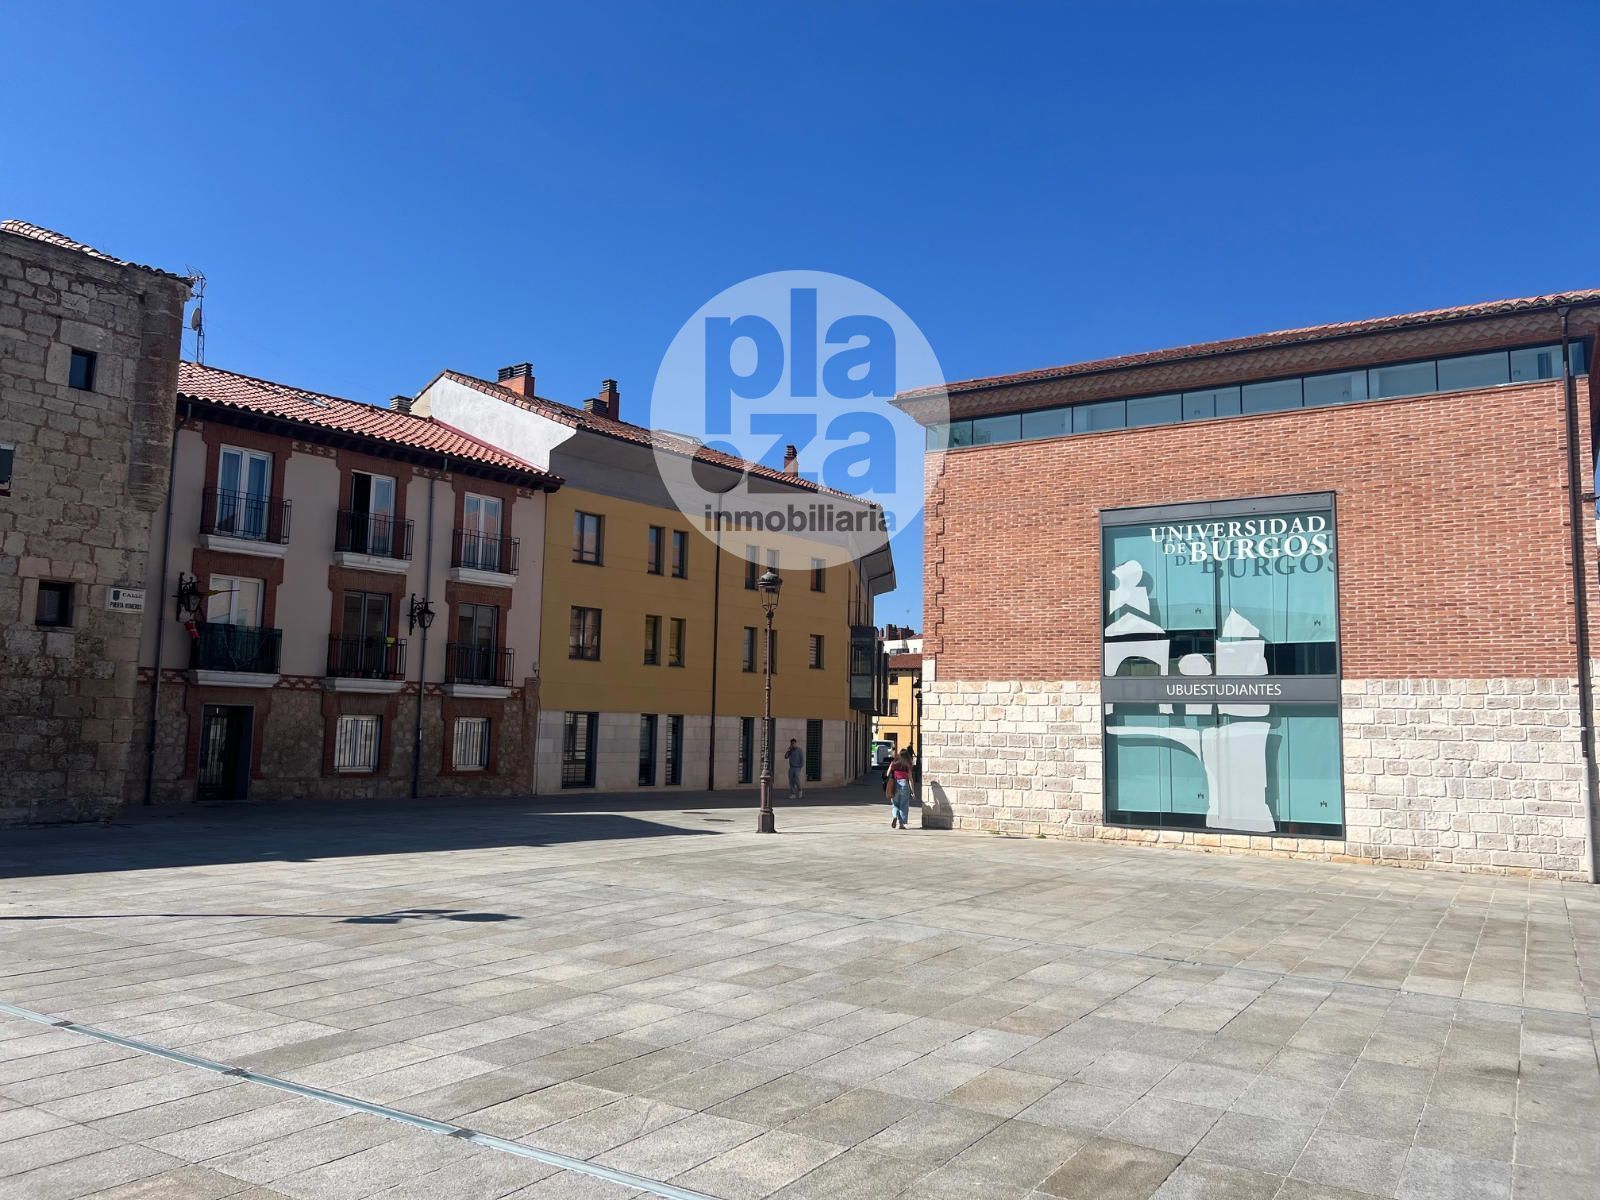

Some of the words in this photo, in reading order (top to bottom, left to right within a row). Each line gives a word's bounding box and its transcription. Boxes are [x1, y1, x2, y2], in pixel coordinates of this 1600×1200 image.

[1150, 516, 1326, 543] UNIVERSIDAD
[1164, 543, 1187, 555] DE
[1189, 533, 1328, 563] BURGOS
[1166, 684, 1282, 696] UBUESTUDIANTES
